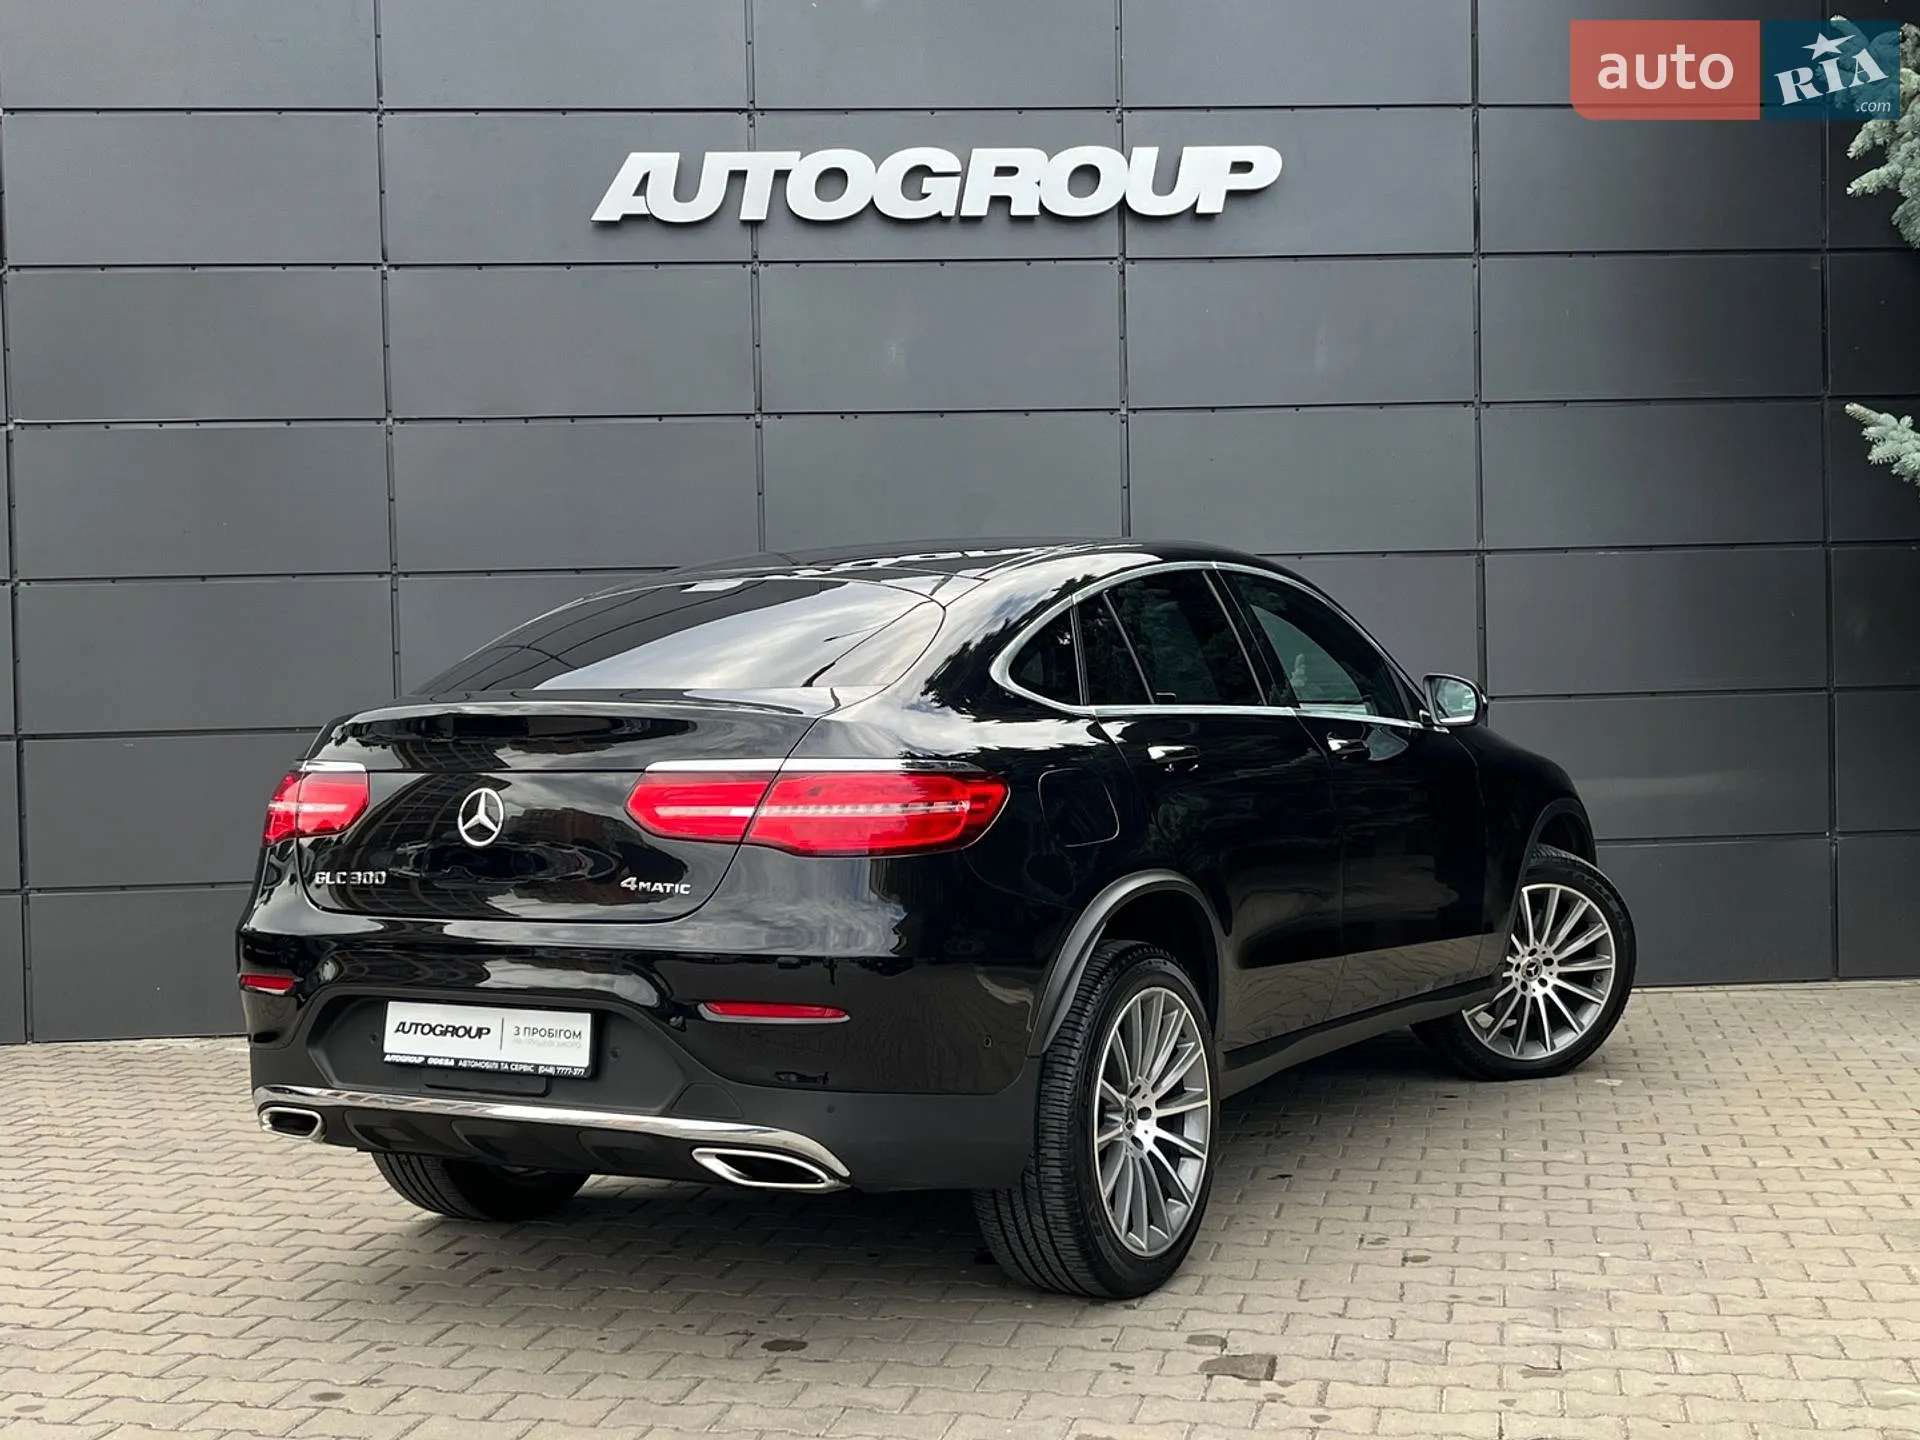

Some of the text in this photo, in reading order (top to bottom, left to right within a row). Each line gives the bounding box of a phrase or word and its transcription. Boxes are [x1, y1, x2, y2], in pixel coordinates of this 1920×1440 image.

[592, 146, 1282, 223] AUTOGROUP
[314, 871, 387, 886] GLC 300
[620, 876, 691, 895] 4MATIC
[394, 1021, 492, 1040] AUTOGROUP
[523, 1026, 582, 1040] ПРОБІГОМ
